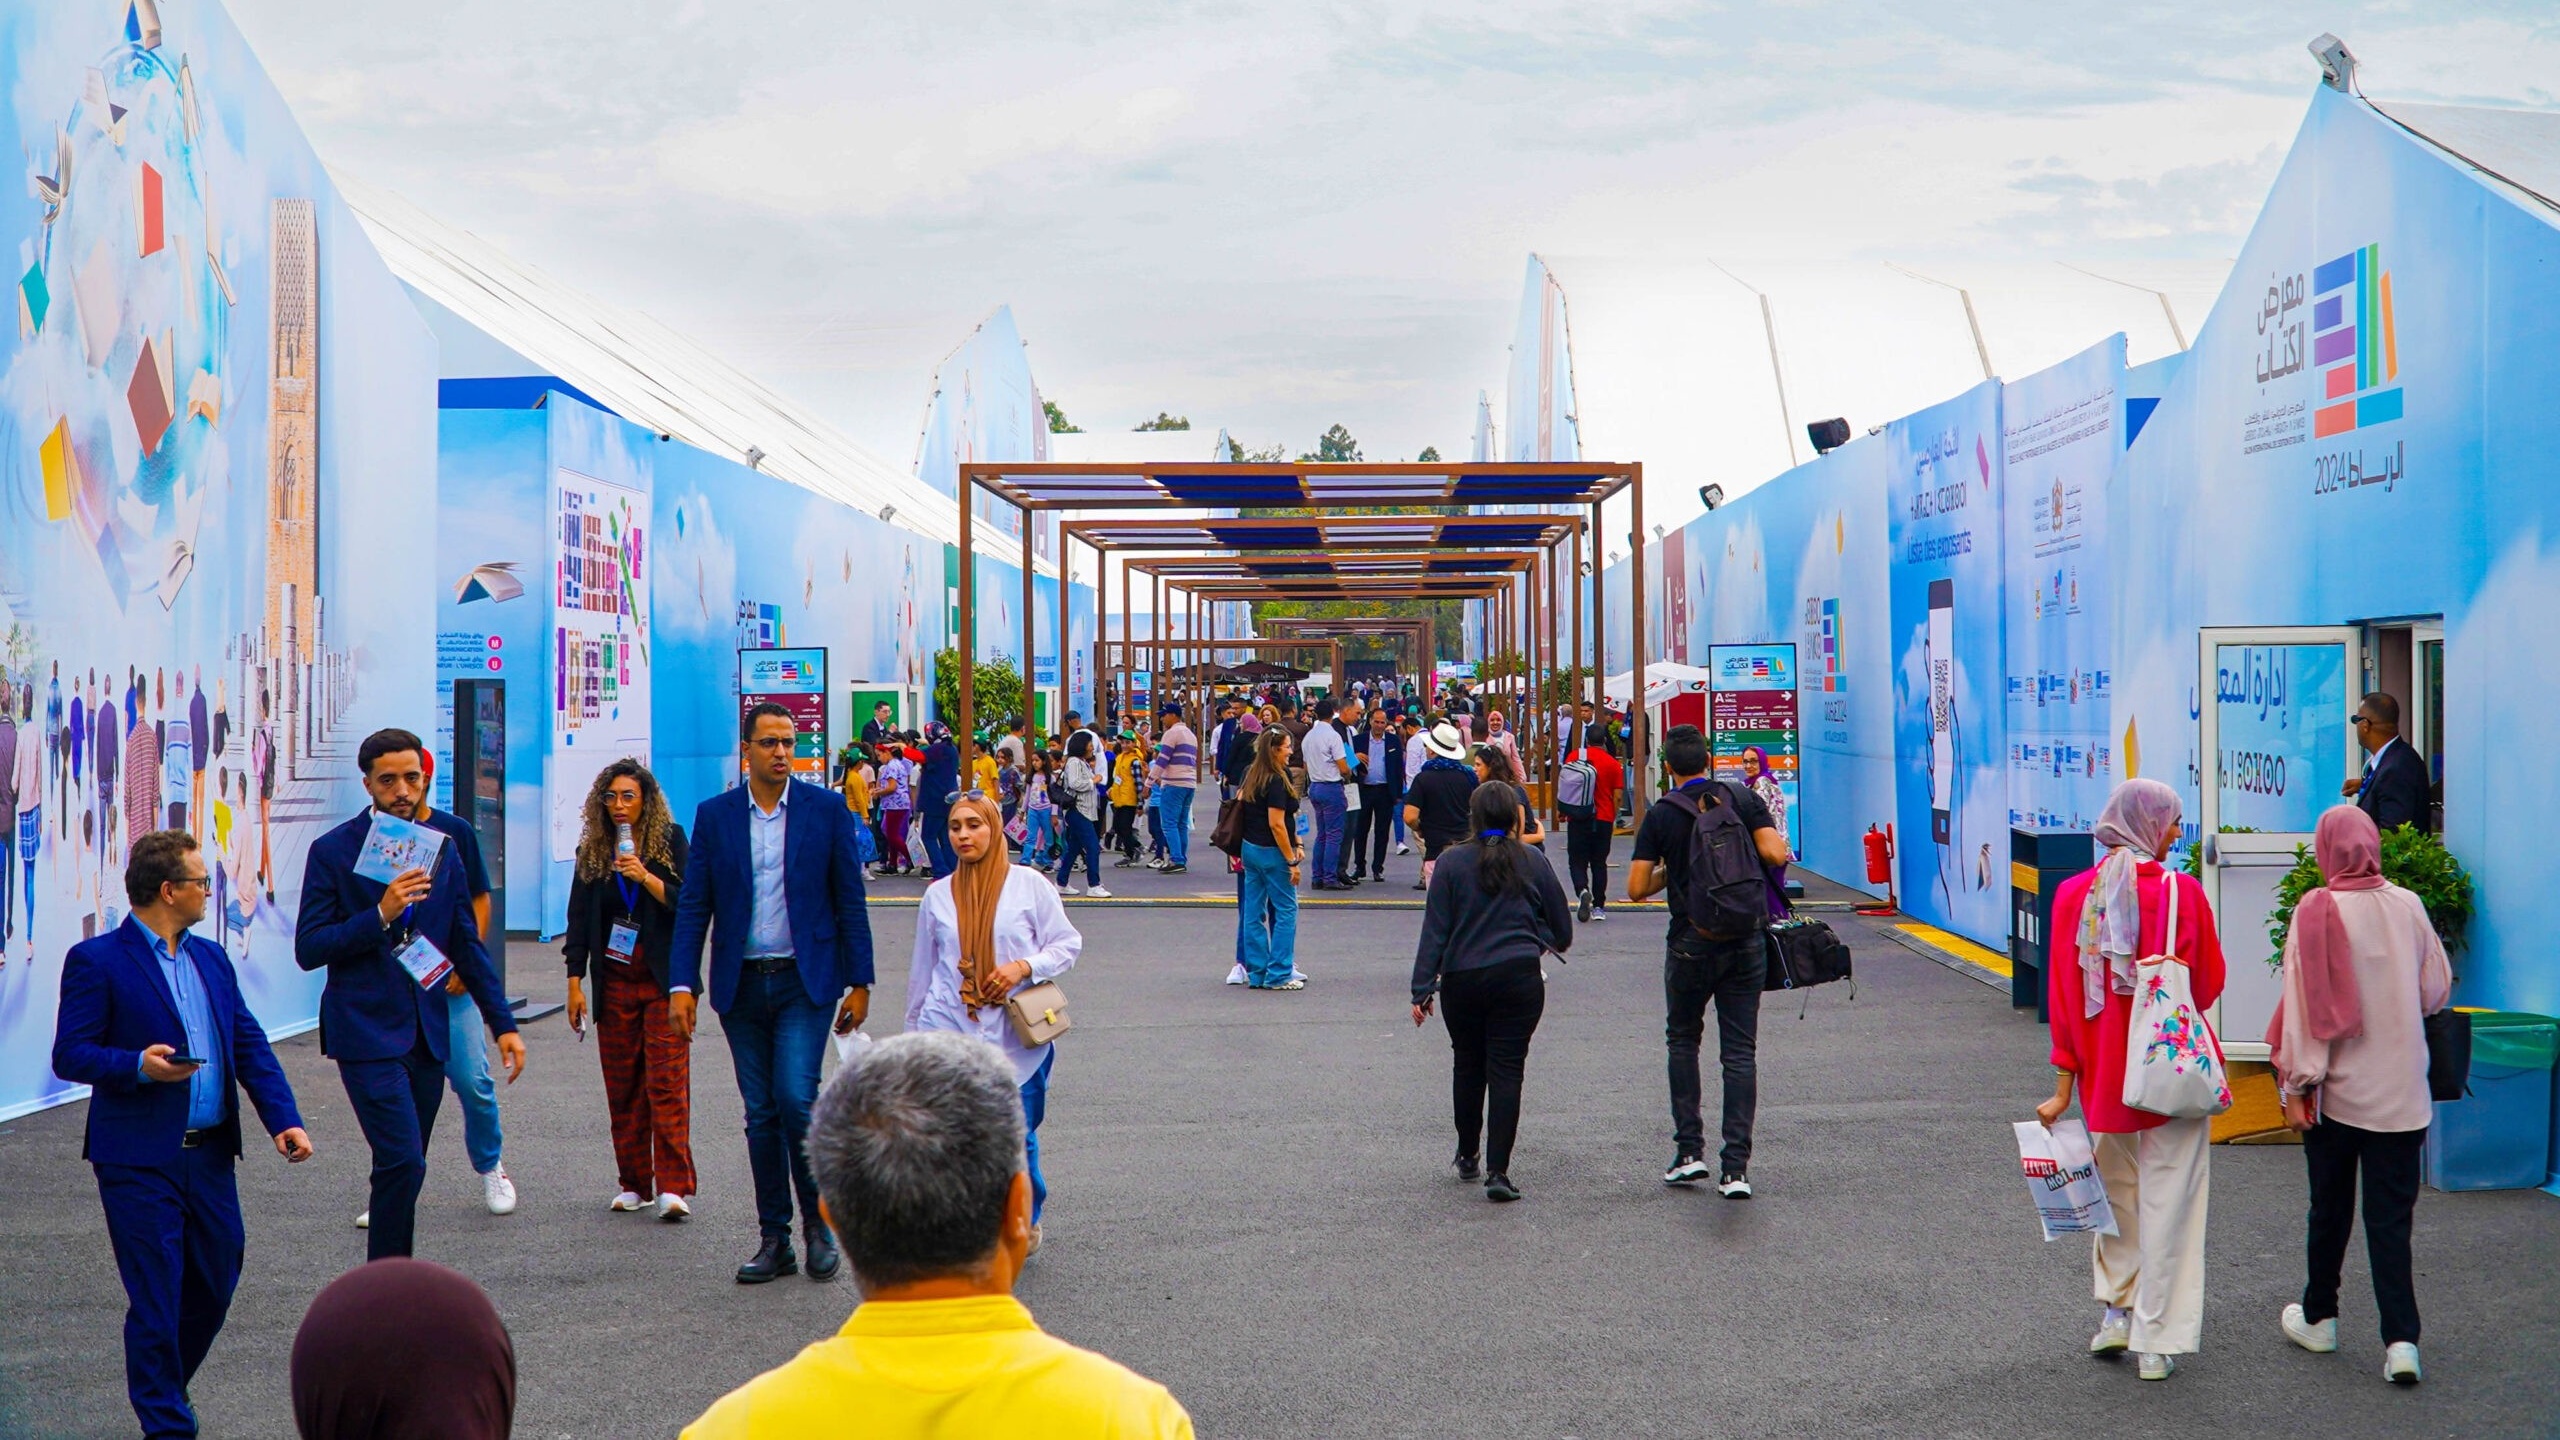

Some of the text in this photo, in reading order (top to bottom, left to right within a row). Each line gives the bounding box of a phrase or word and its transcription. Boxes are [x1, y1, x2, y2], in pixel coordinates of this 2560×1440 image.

[2257, 271, 2304, 335] معرض
[2257, 320, 2304, 396] الكتاب
[2314, 451, 2346, 495] 2024
[2348, 440, 2403, 493] الرباط
[1907, 524, 1972, 567] Liste des exposants
[492, 639, 499, 648] M
[492, 660, 498, 669] U
[1715, 692, 1724, 703] A
[2253, 648, 2287, 731] إدارة
[744, 695, 754, 706] A
[1715, 718, 1758, 730] B C D E
[1715, 732, 1724, 743] F
[2023, 1160, 2056, 1176] LIVRE
